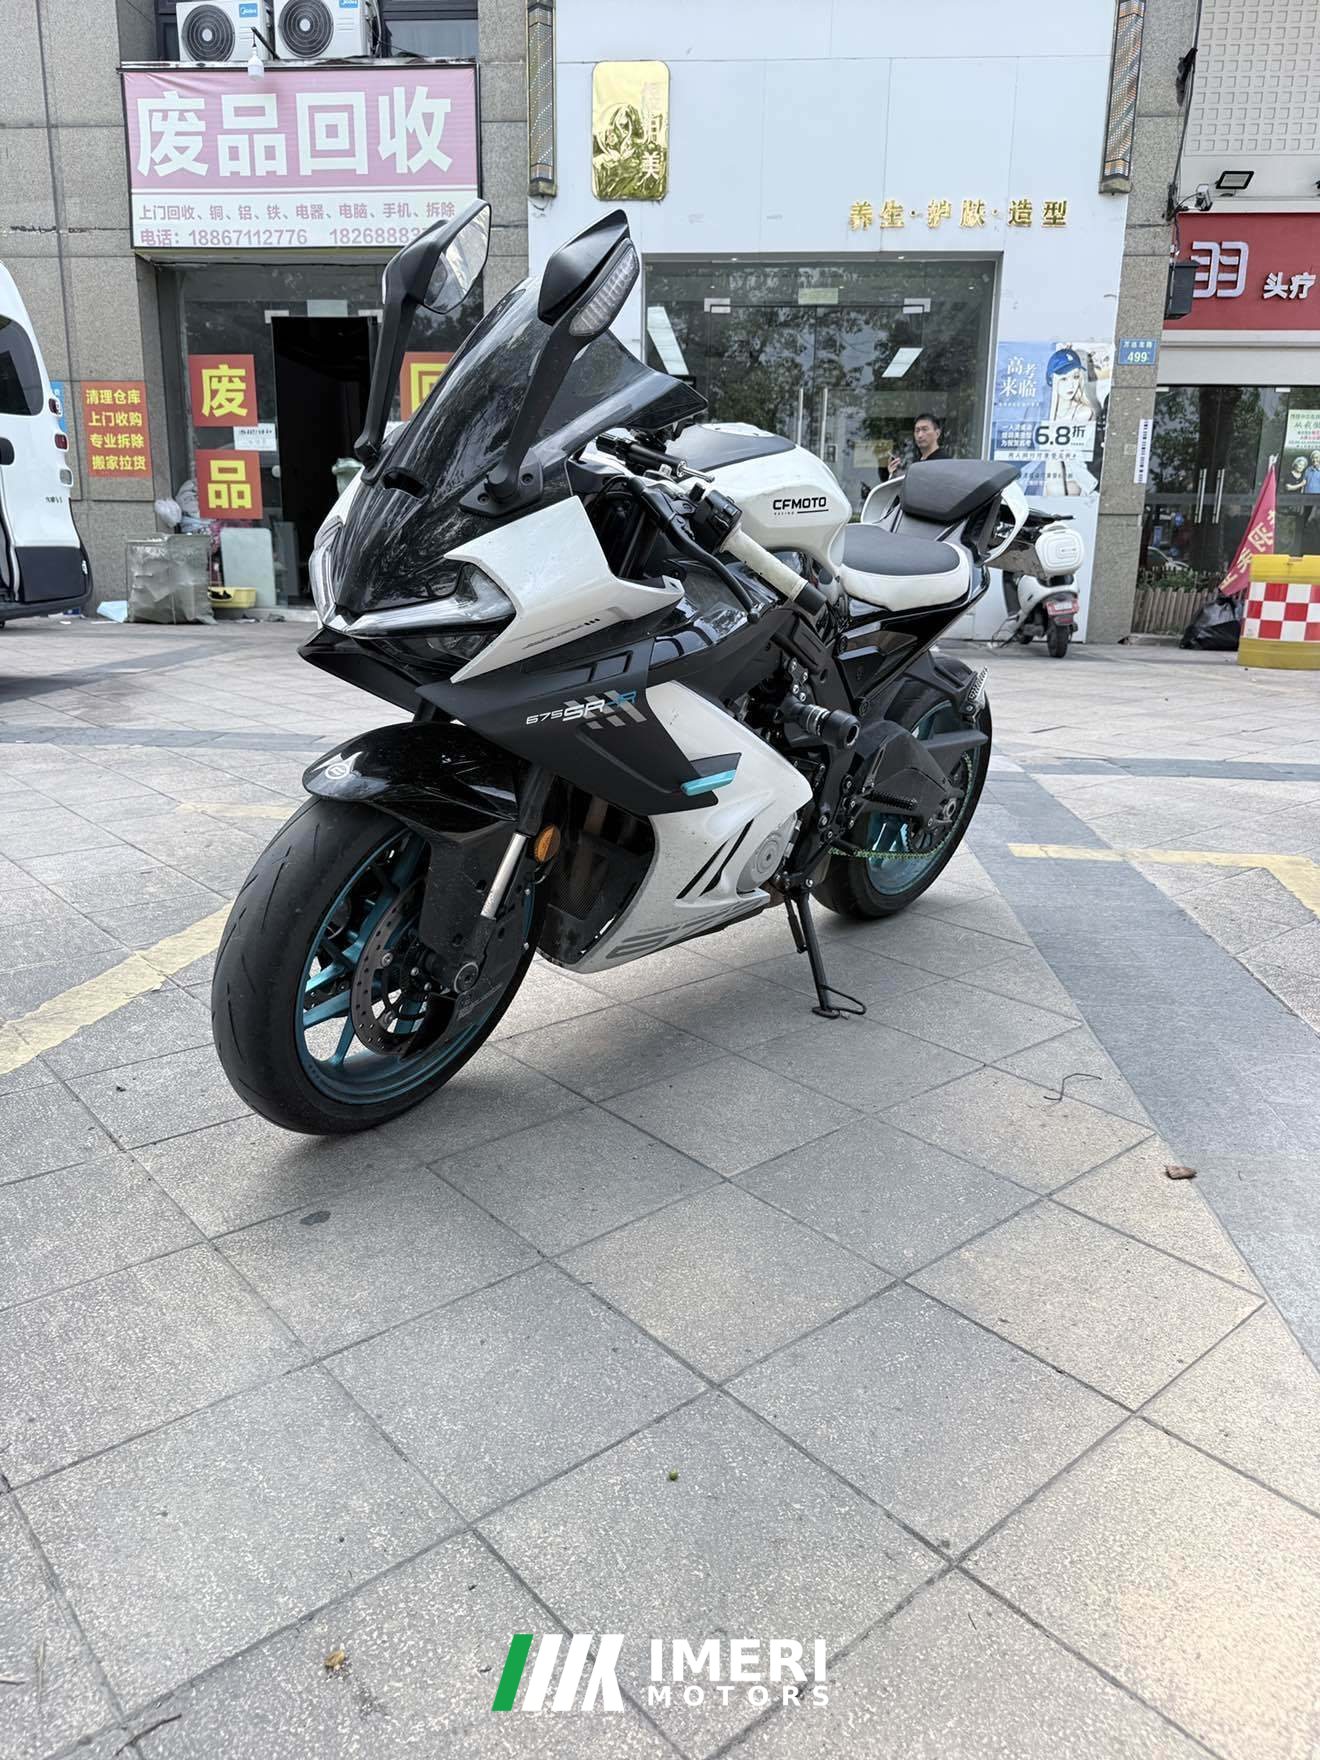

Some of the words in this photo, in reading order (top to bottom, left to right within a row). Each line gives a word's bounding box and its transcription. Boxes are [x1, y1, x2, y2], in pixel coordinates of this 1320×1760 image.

[137, 86, 453, 177] 废品回收
[329, 227, 427, 245] 18268883
[1263, 271, 1317, 299] 头疗
[1127, 351, 1148, 363] 499
[1007, 356, 1037, 379] 高考
[86, 388, 141, 405] 清理仓库
[202, 363, 248, 417] 废
[1000, 376, 1037, 398] 来临
[88, 411, 143, 427] 上门收购
[89, 433, 145, 449] 专业拆除
[1034, 425, 1086, 446] 6.8折
[92, 455, 147, 471] 搬家拉货
[207, 459, 252, 509] 品
[772, 496, 827, 510] CFMOTO
